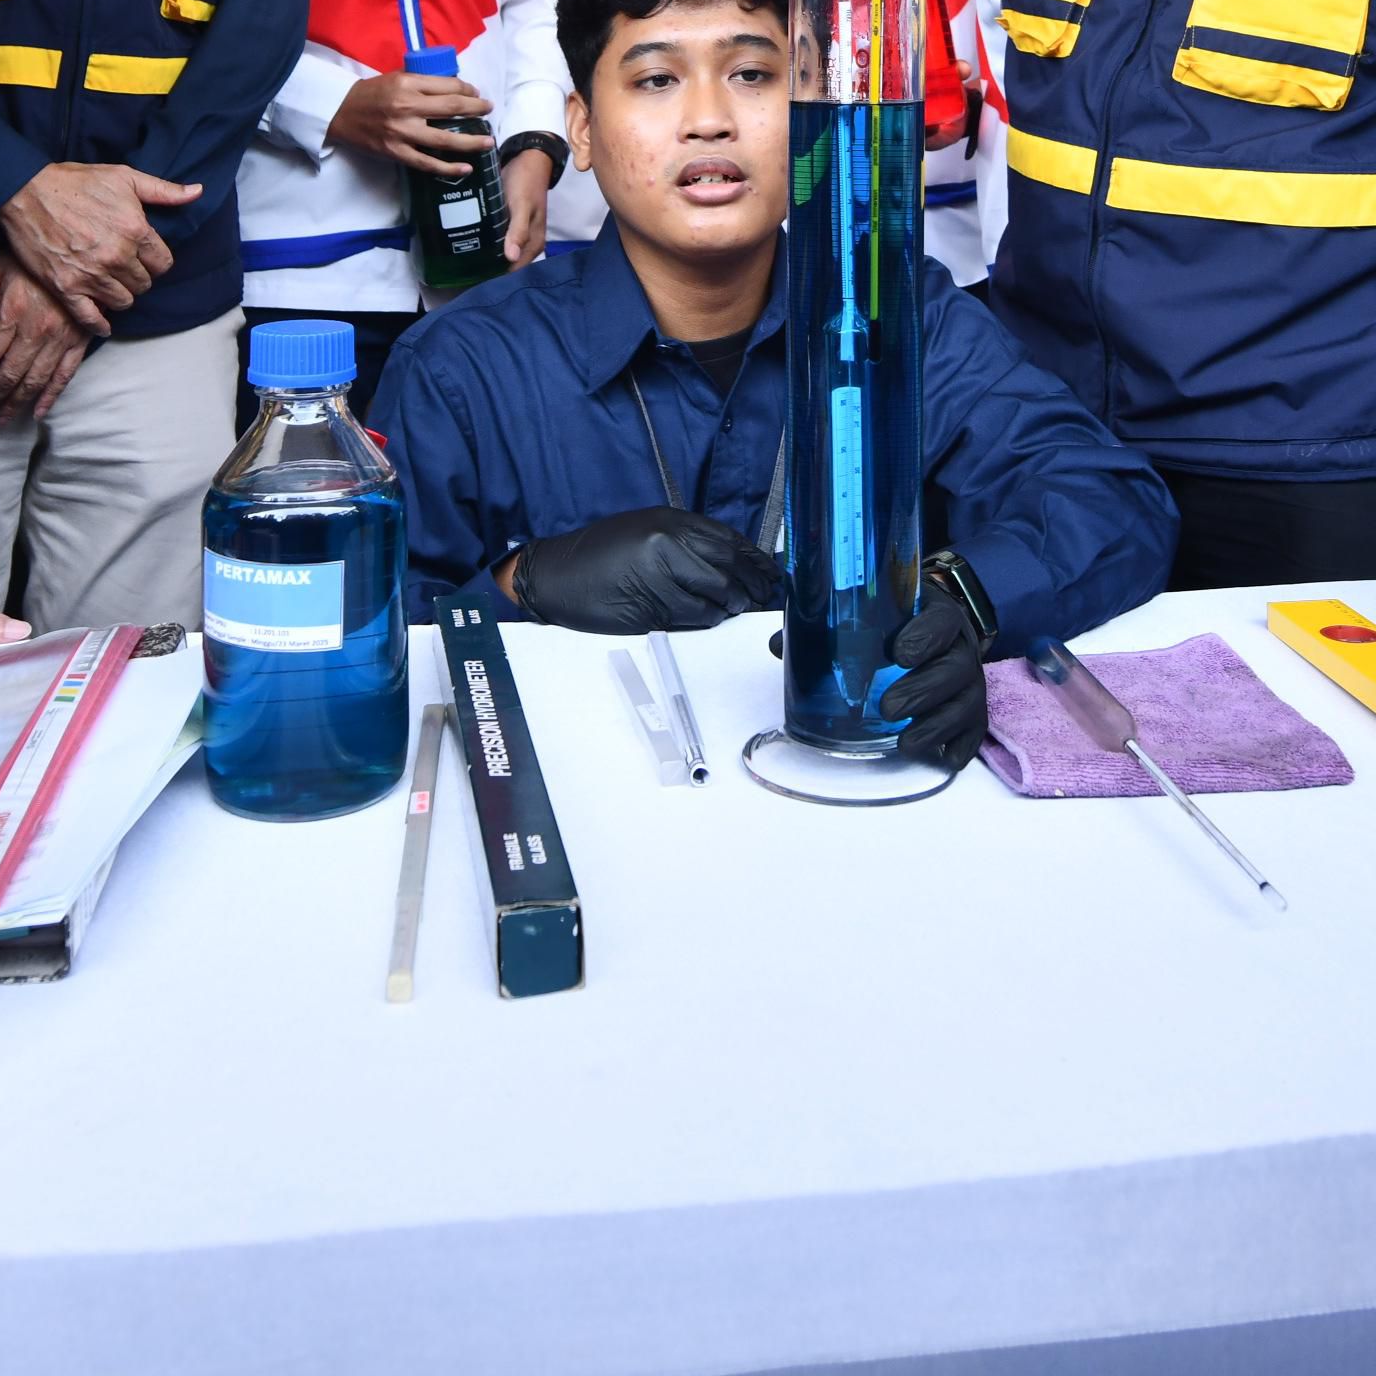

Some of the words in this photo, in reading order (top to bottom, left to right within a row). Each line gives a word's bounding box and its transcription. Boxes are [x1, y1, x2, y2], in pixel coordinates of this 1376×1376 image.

[442, 191, 462, 201] 1000
[215, 561, 313, 586] PERTAMAX
[452, 608, 465, 628] FRAGILE
[468, 609, 482, 624] GLASS
[464, 659, 499, 720] HYDROMETER
[477, 720, 513, 777] PRECISION
[503, 832, 525, 871] FRAGILE
[527, 834, 548, 865] GLASS
